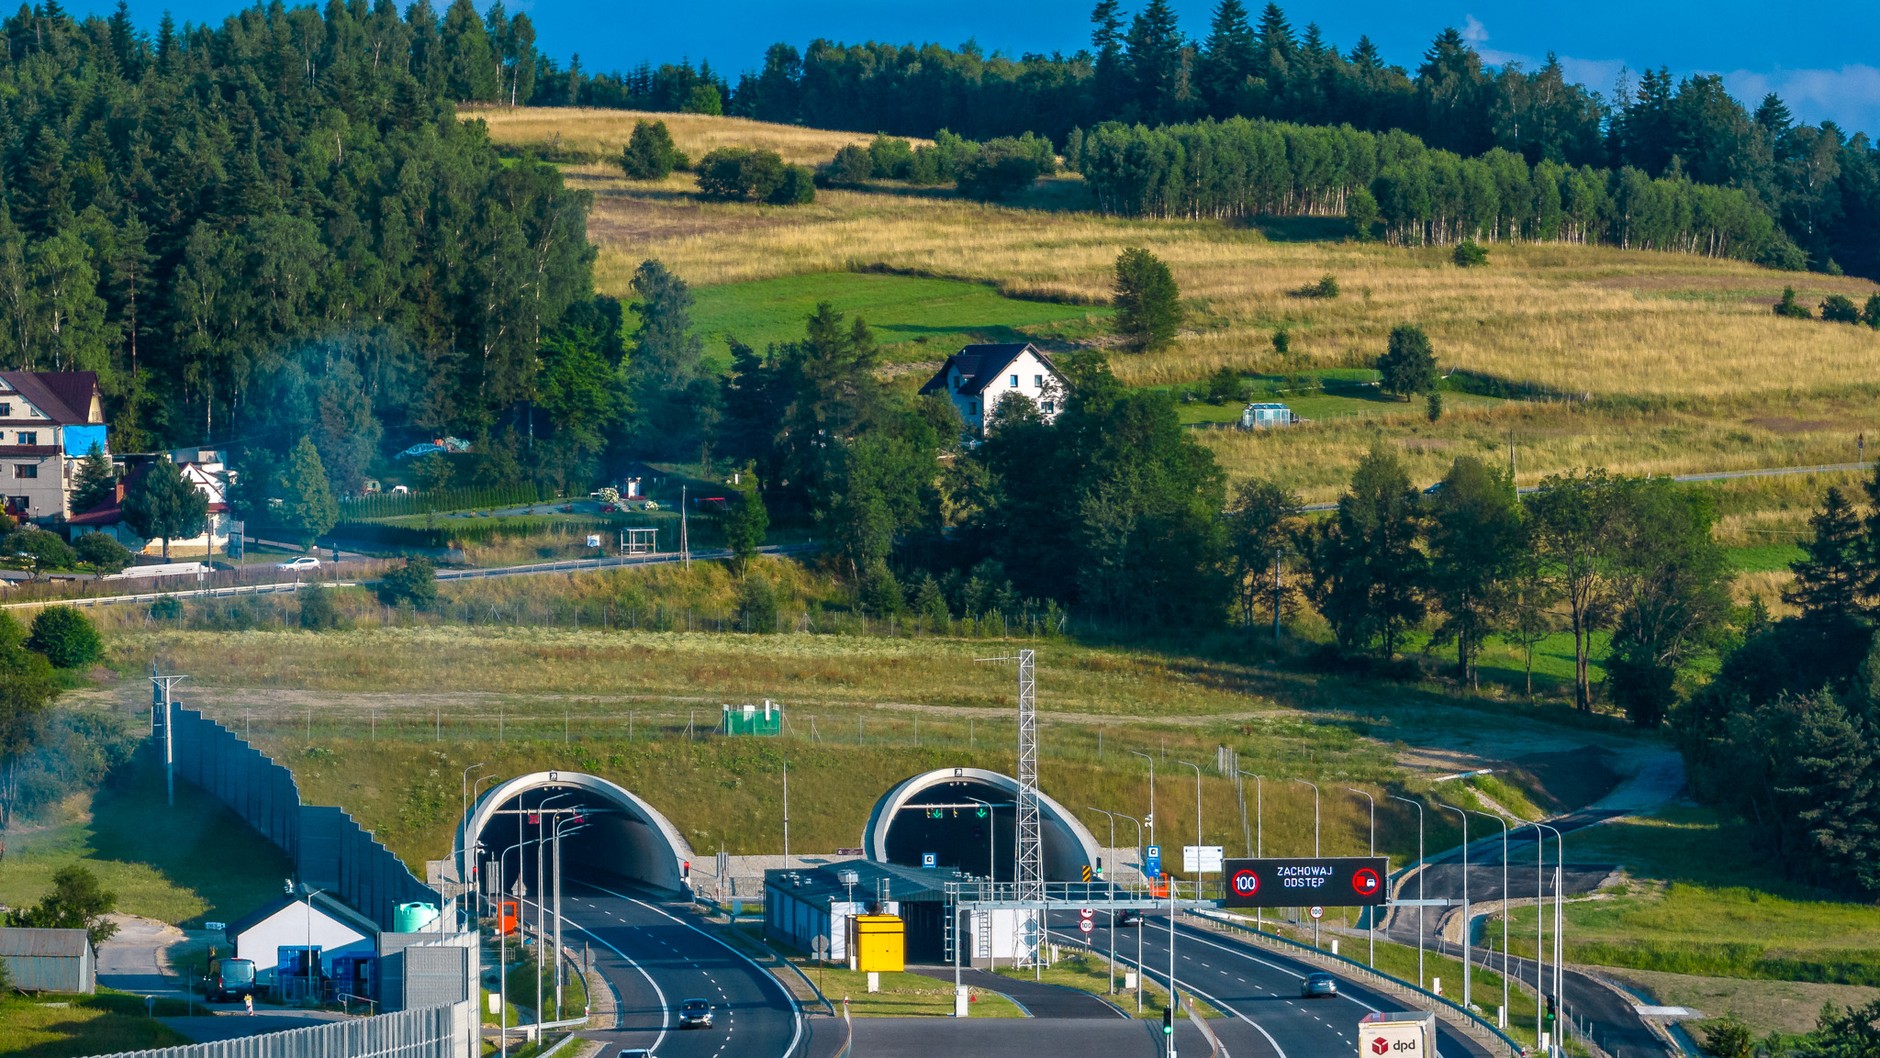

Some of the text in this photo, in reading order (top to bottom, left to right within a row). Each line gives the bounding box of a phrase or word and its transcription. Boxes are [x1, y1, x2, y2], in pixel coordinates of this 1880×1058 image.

[1277, 866, 1333, 876] ZACHOWAJ
[1236, 876, 1256, 890] 100
[1284, 877, 1325, 888] ODSTĘP
[1393, 1039, 1415, 1053] dpd
